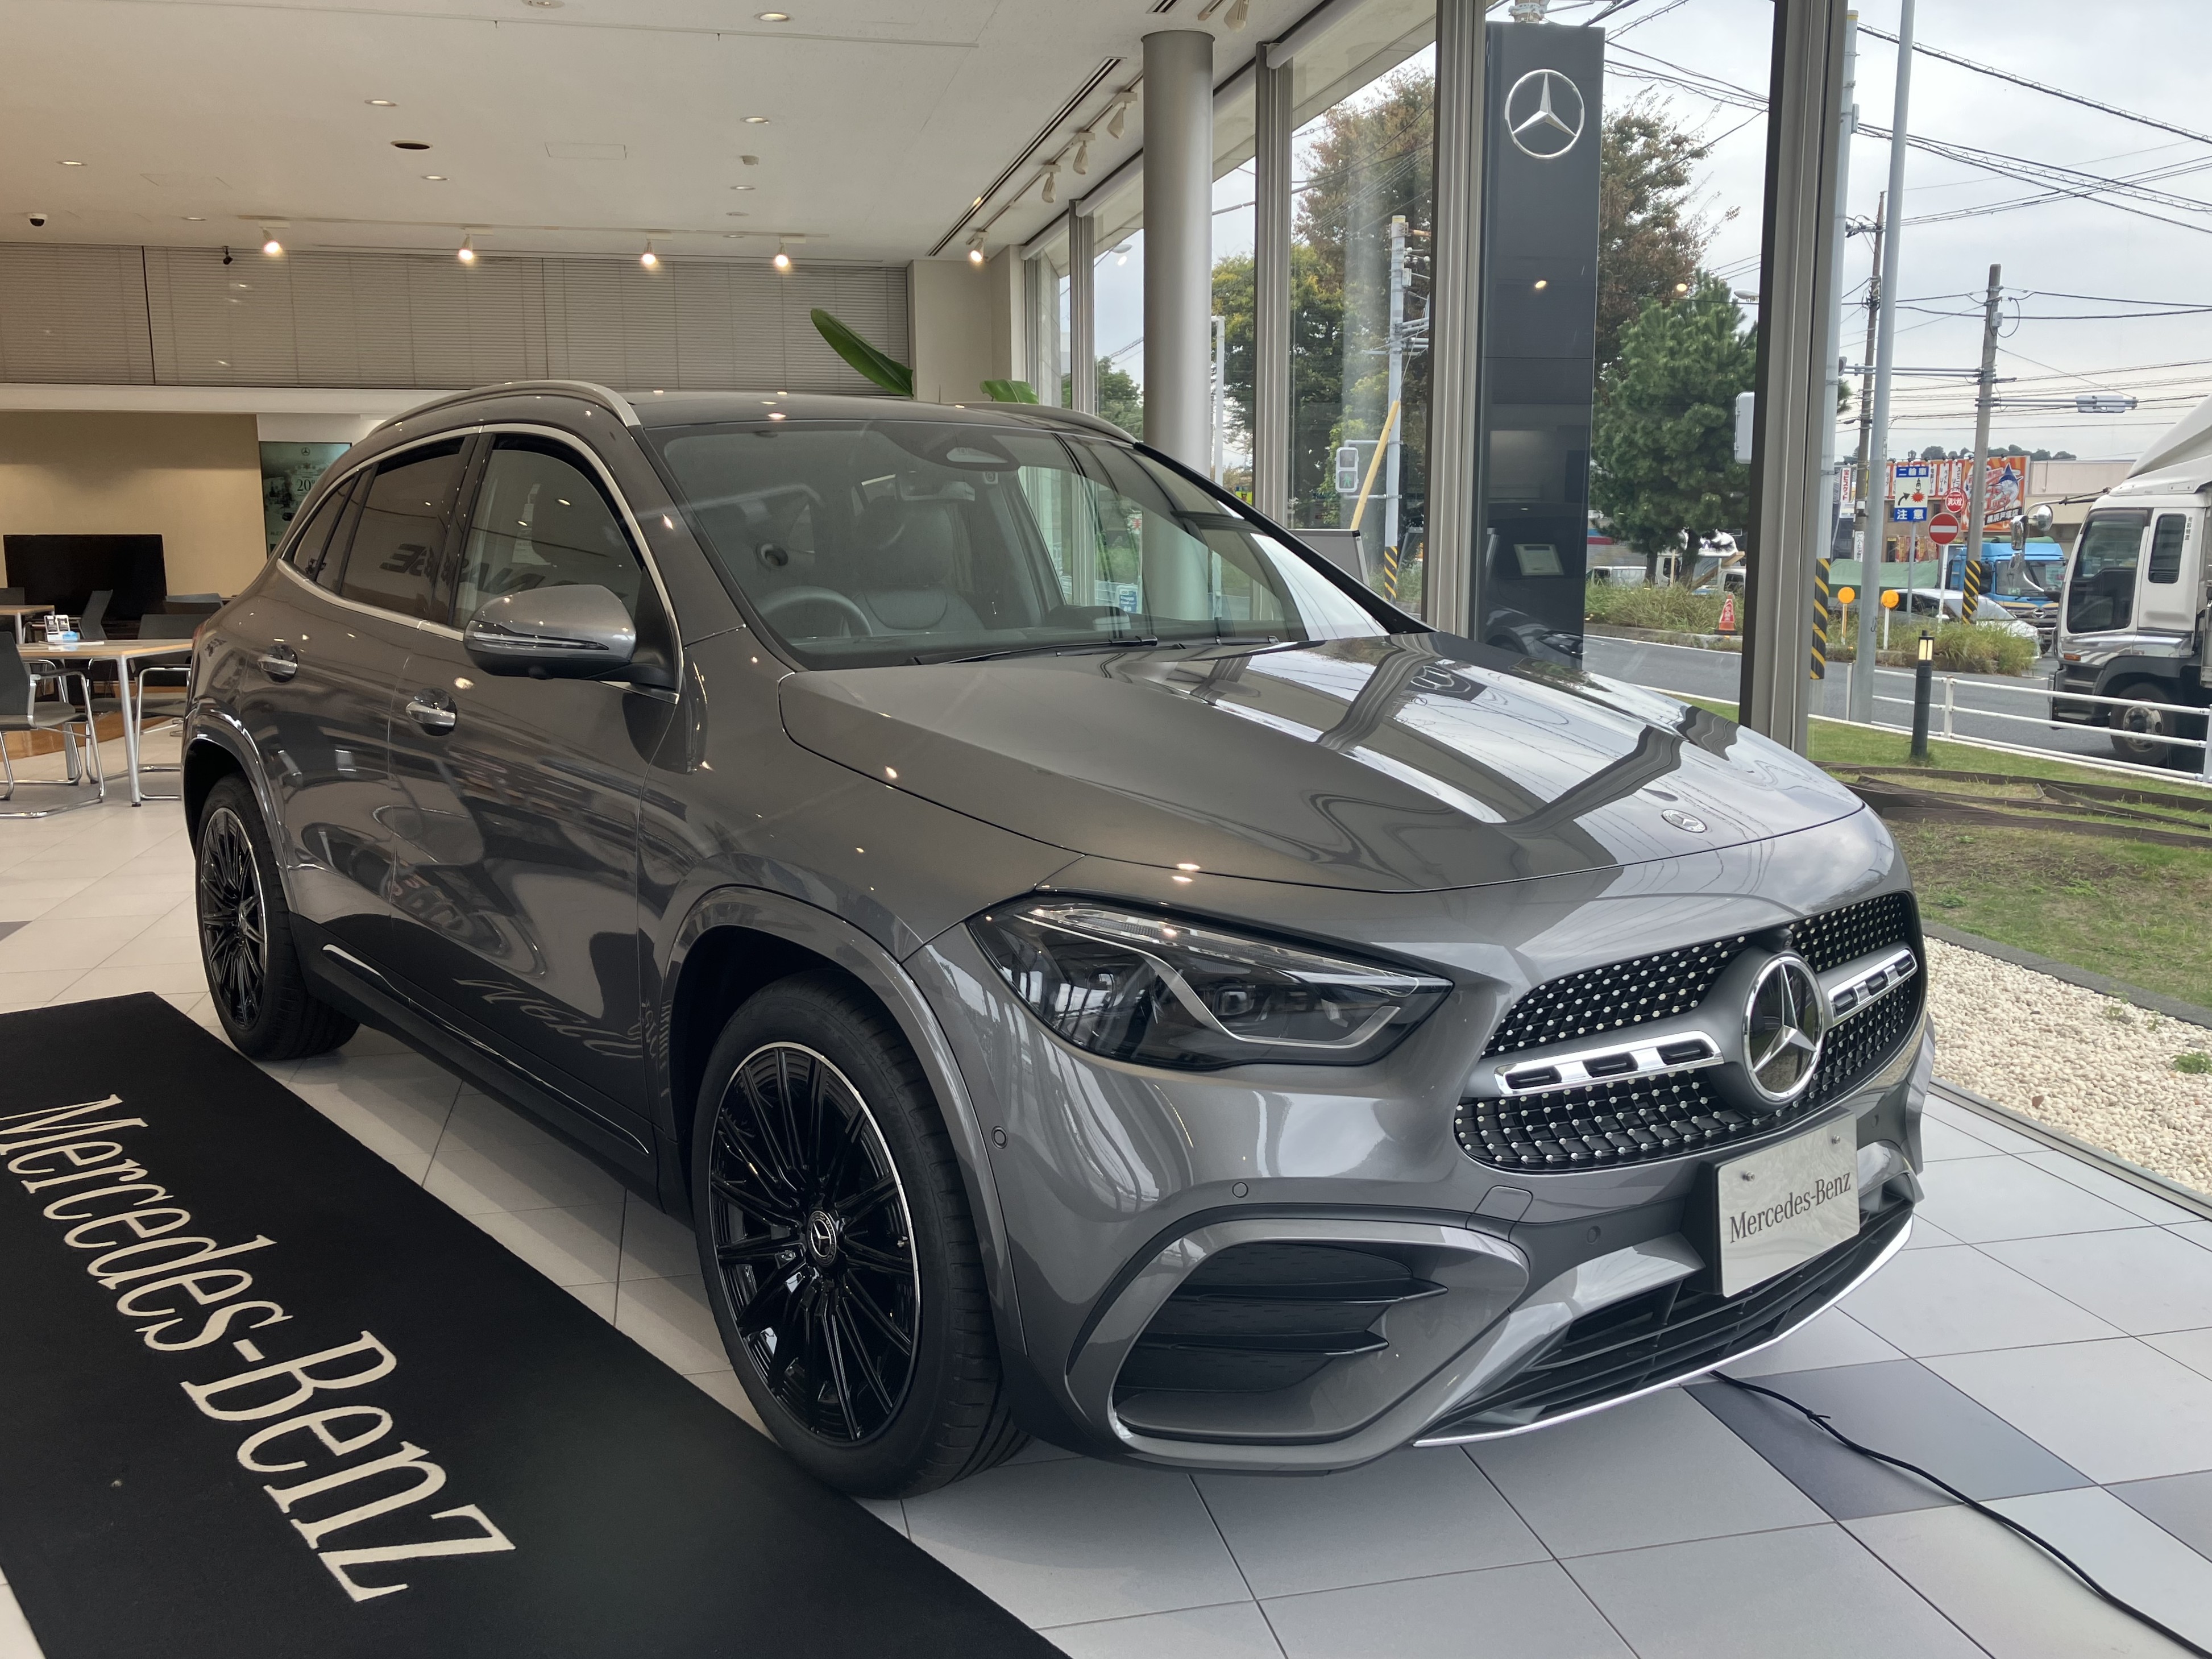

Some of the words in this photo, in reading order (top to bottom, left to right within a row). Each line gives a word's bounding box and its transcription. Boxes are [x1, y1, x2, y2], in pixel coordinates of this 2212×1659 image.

[1898, 467, 1927, 476] 二輪車
[1947, 497, 1962, 506] 消火栓
[1896, 509, 1924, 520] 注意
[1730, 1172, 1851, 1244] Mercedes-Benz
[0, 1094, 516, 1602] Mercedes-Benz
